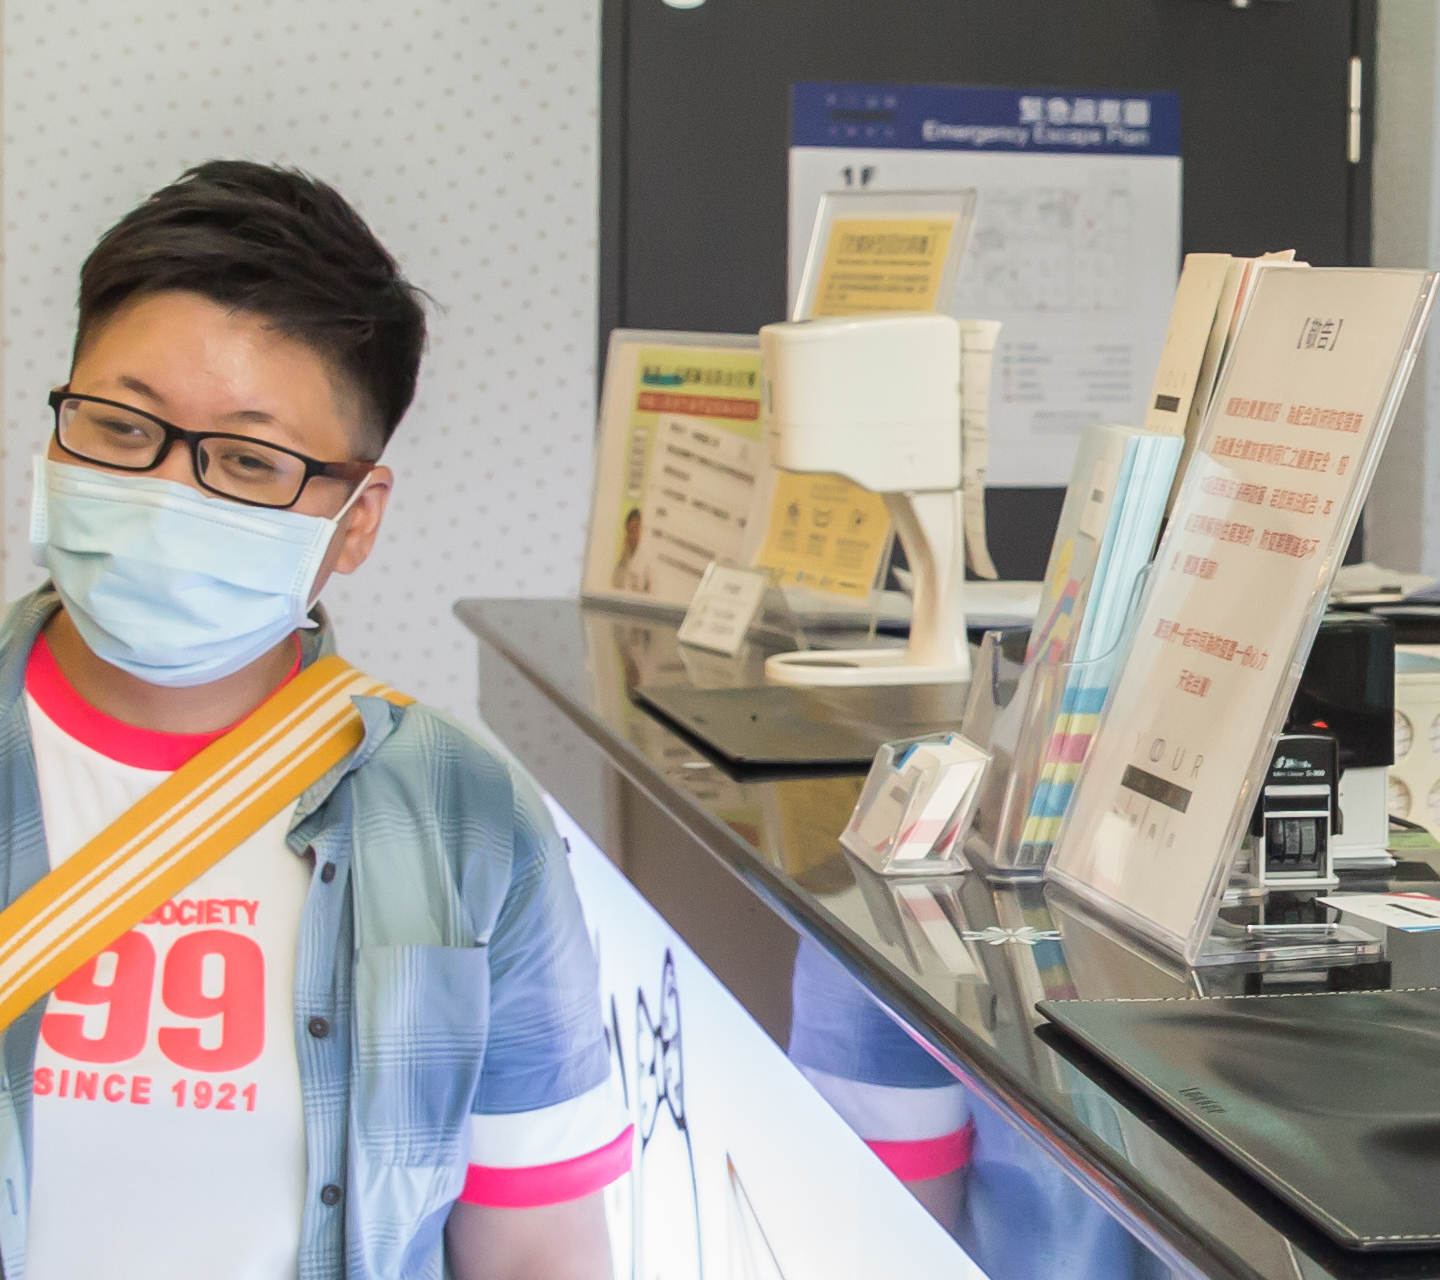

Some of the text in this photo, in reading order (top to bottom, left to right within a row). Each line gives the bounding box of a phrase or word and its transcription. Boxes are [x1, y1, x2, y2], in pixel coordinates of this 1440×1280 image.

[921, 119, 1151, 148] Emergency Escape Plan
[840, 164, 877, 188] 1F
[40, 929, 265, 1073] 99
[32, 1066, 259, 1112] SINCE 1921
